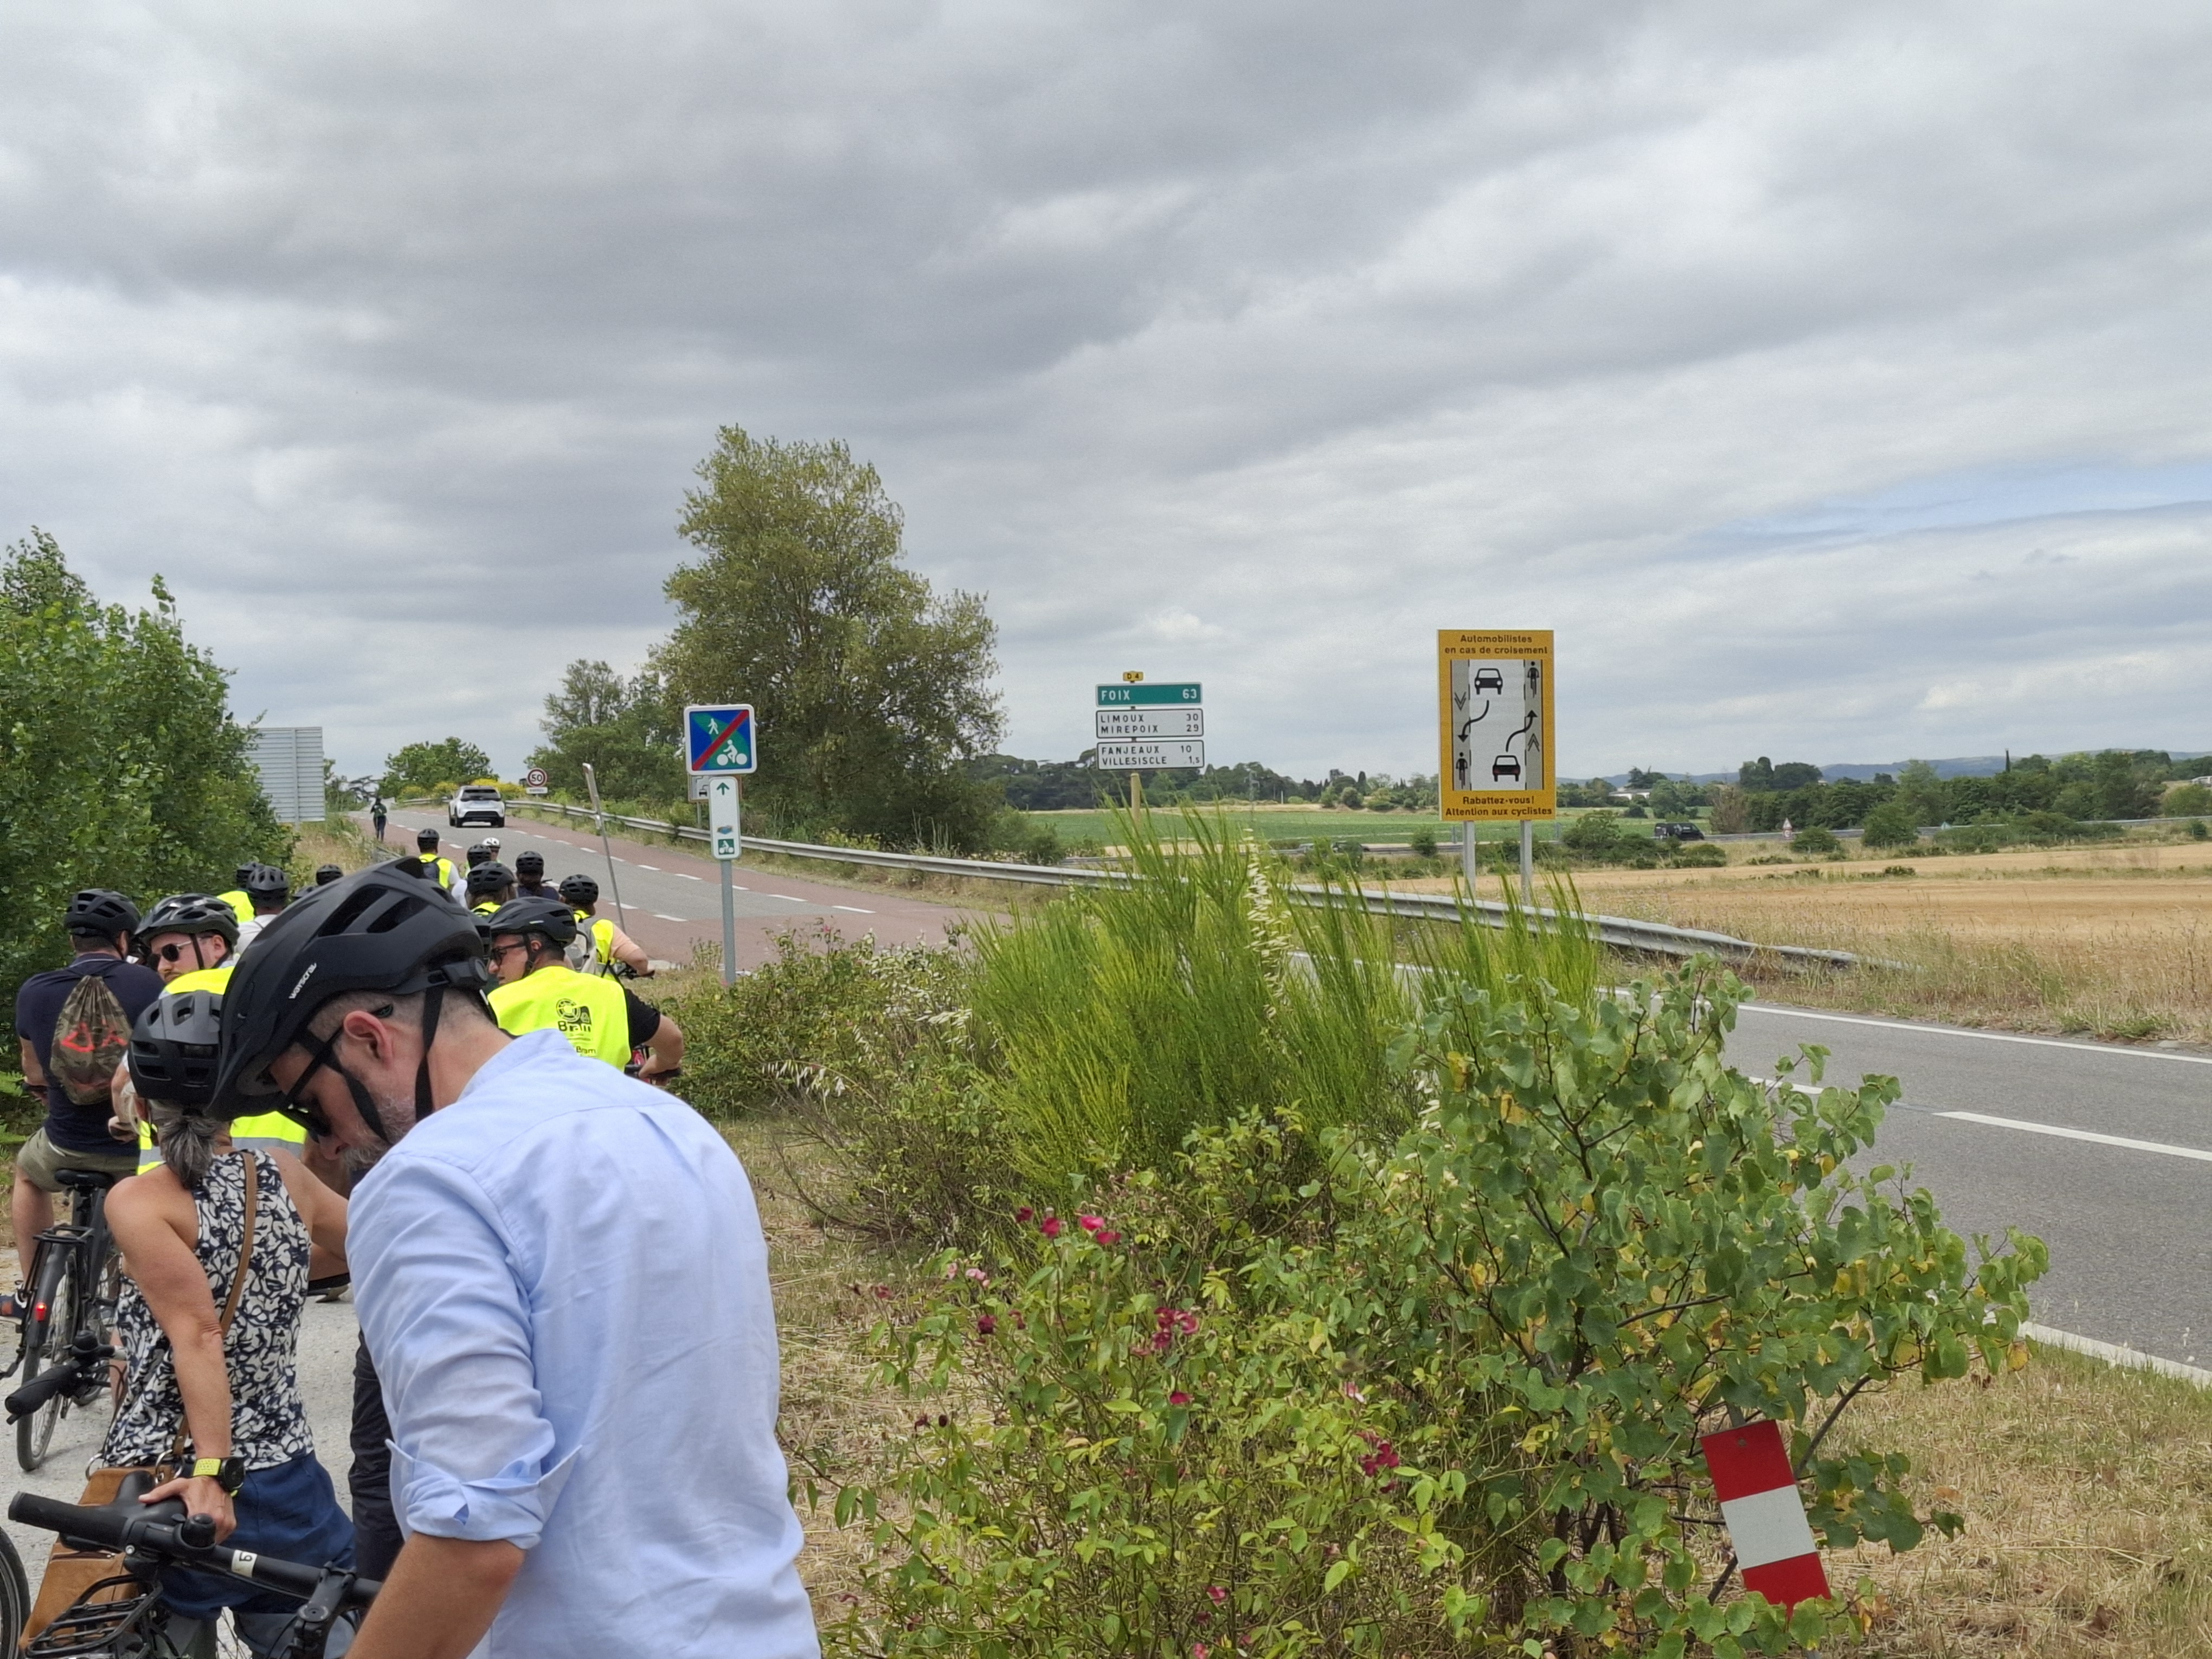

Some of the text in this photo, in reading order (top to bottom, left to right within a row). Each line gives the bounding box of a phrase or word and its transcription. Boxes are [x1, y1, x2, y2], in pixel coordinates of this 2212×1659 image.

[1460, 635, 1533, 643] Automobilistes
[1479, 646, 1490, 654] de
[1494, 646, 1548, 654] croisement
[1101, 689, 1197, 701] FOIX 63
[1101, 713, 1199, 723] LIMOUX 30
[1101, 724, 1199, 734] MIREPOIX 29
[1102, 745, 1192, 755] FANJEAUX 10
[1102, 755, 1200, 766] VILLESISCLE 1,5
[1446, 808, 1489, 816] Attention
[1511, 806, 1552, 816] cyclistes
